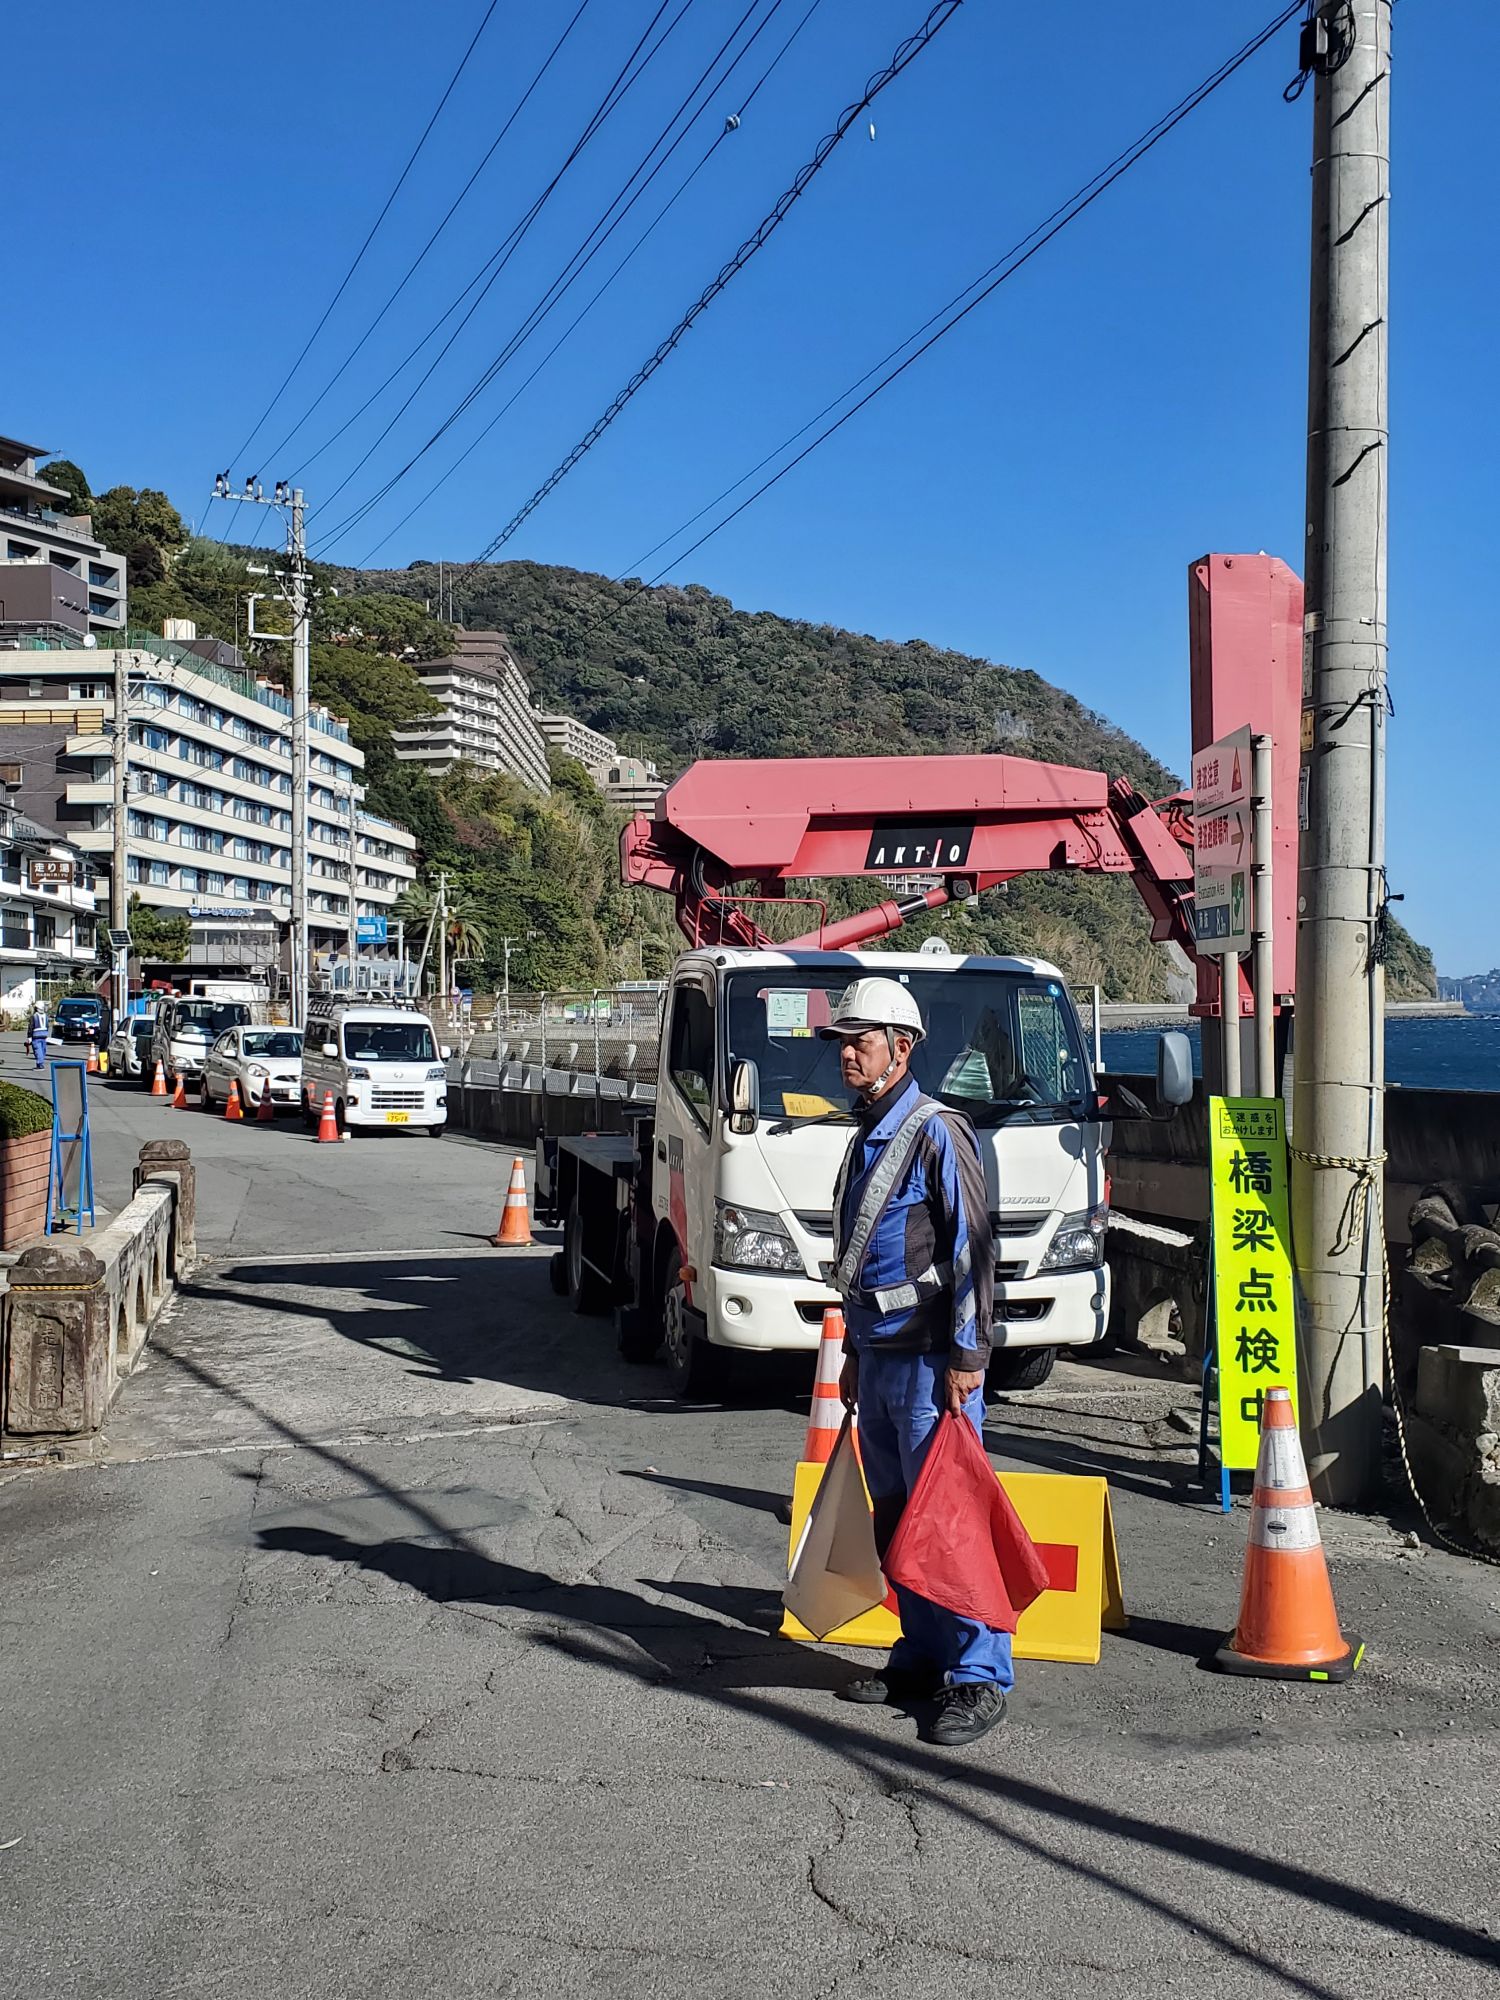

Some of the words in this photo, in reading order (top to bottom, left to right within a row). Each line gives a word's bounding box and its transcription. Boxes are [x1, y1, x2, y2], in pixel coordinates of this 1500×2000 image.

[874, 839, 960, 868] AKTIO
[34, 863, 70, 873] 走り湯
[1223, 1112, 1273, 1123] ご迷惑を
[1223, 1126, 1274, 1136] おかけします
